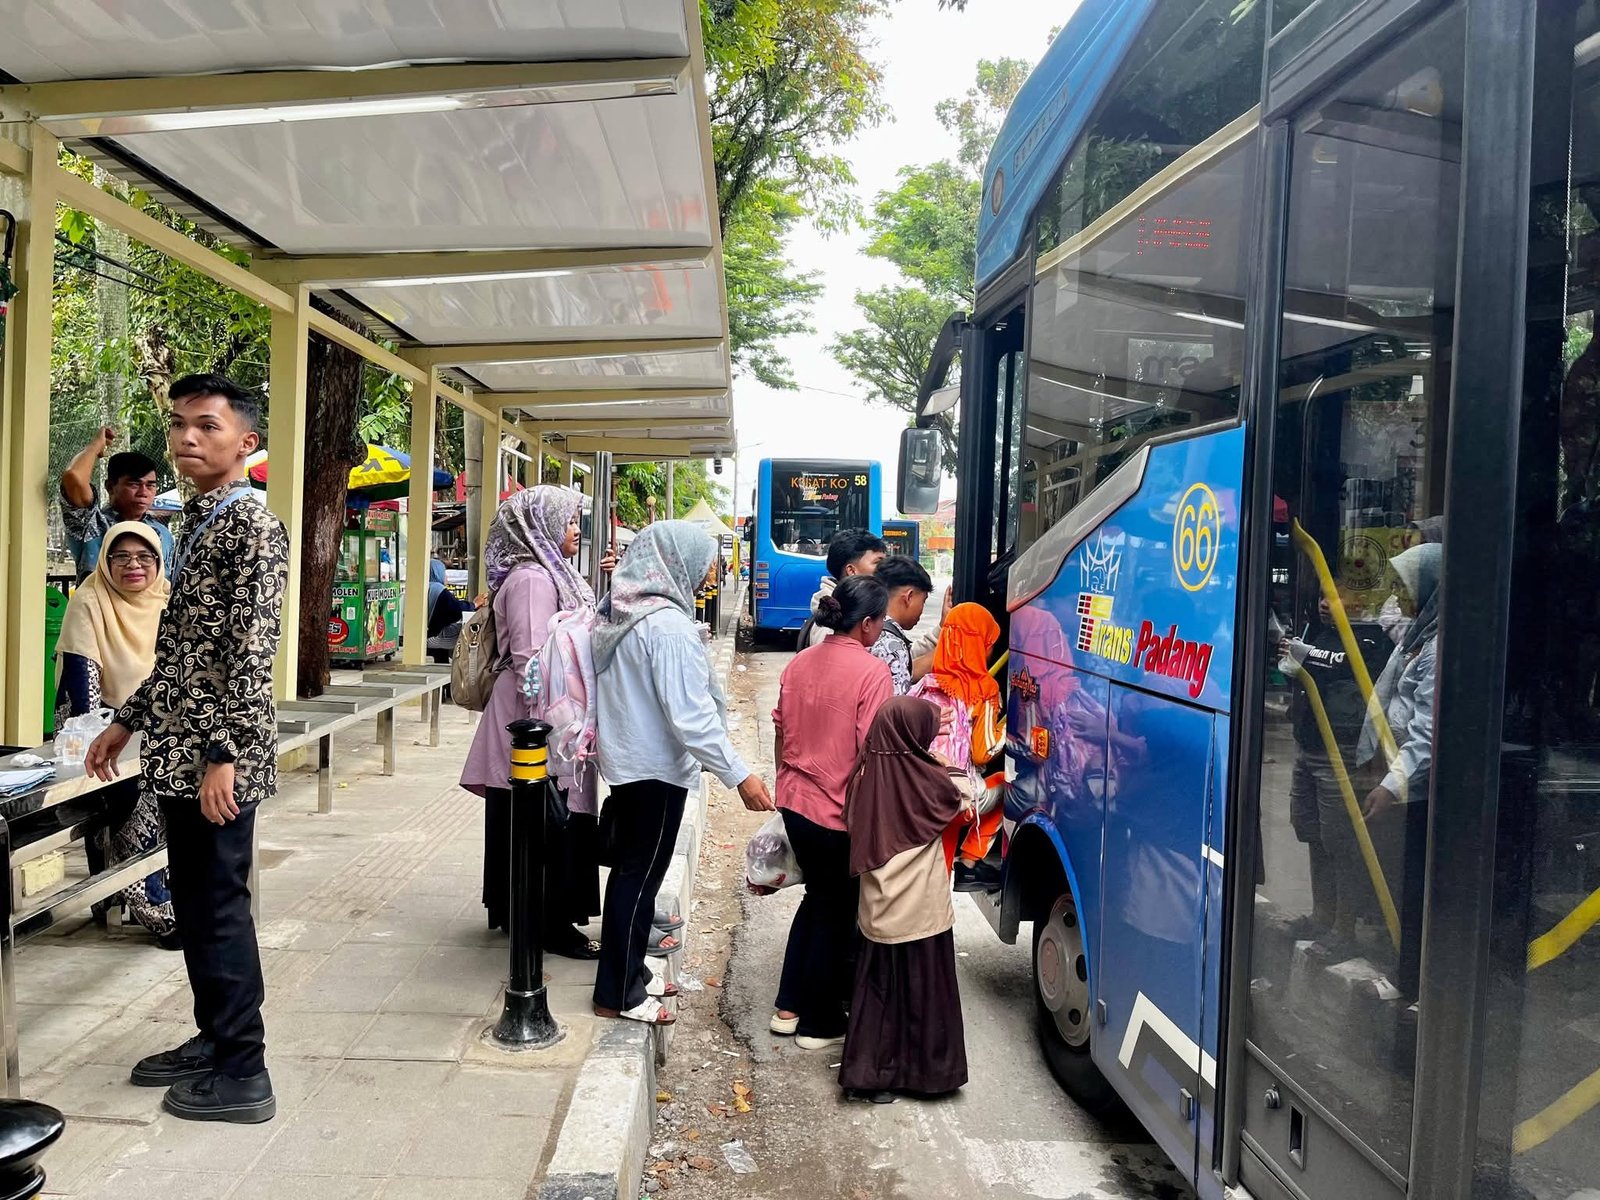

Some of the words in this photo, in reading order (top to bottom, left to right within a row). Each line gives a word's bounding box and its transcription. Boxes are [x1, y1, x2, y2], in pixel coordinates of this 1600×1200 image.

[854, 475, 867, 486] 58
[1180, 502, 1213, 573] 66
[1077, 592, 1134, 664] Trans
[1134, 621, 1214, 698] Padang
